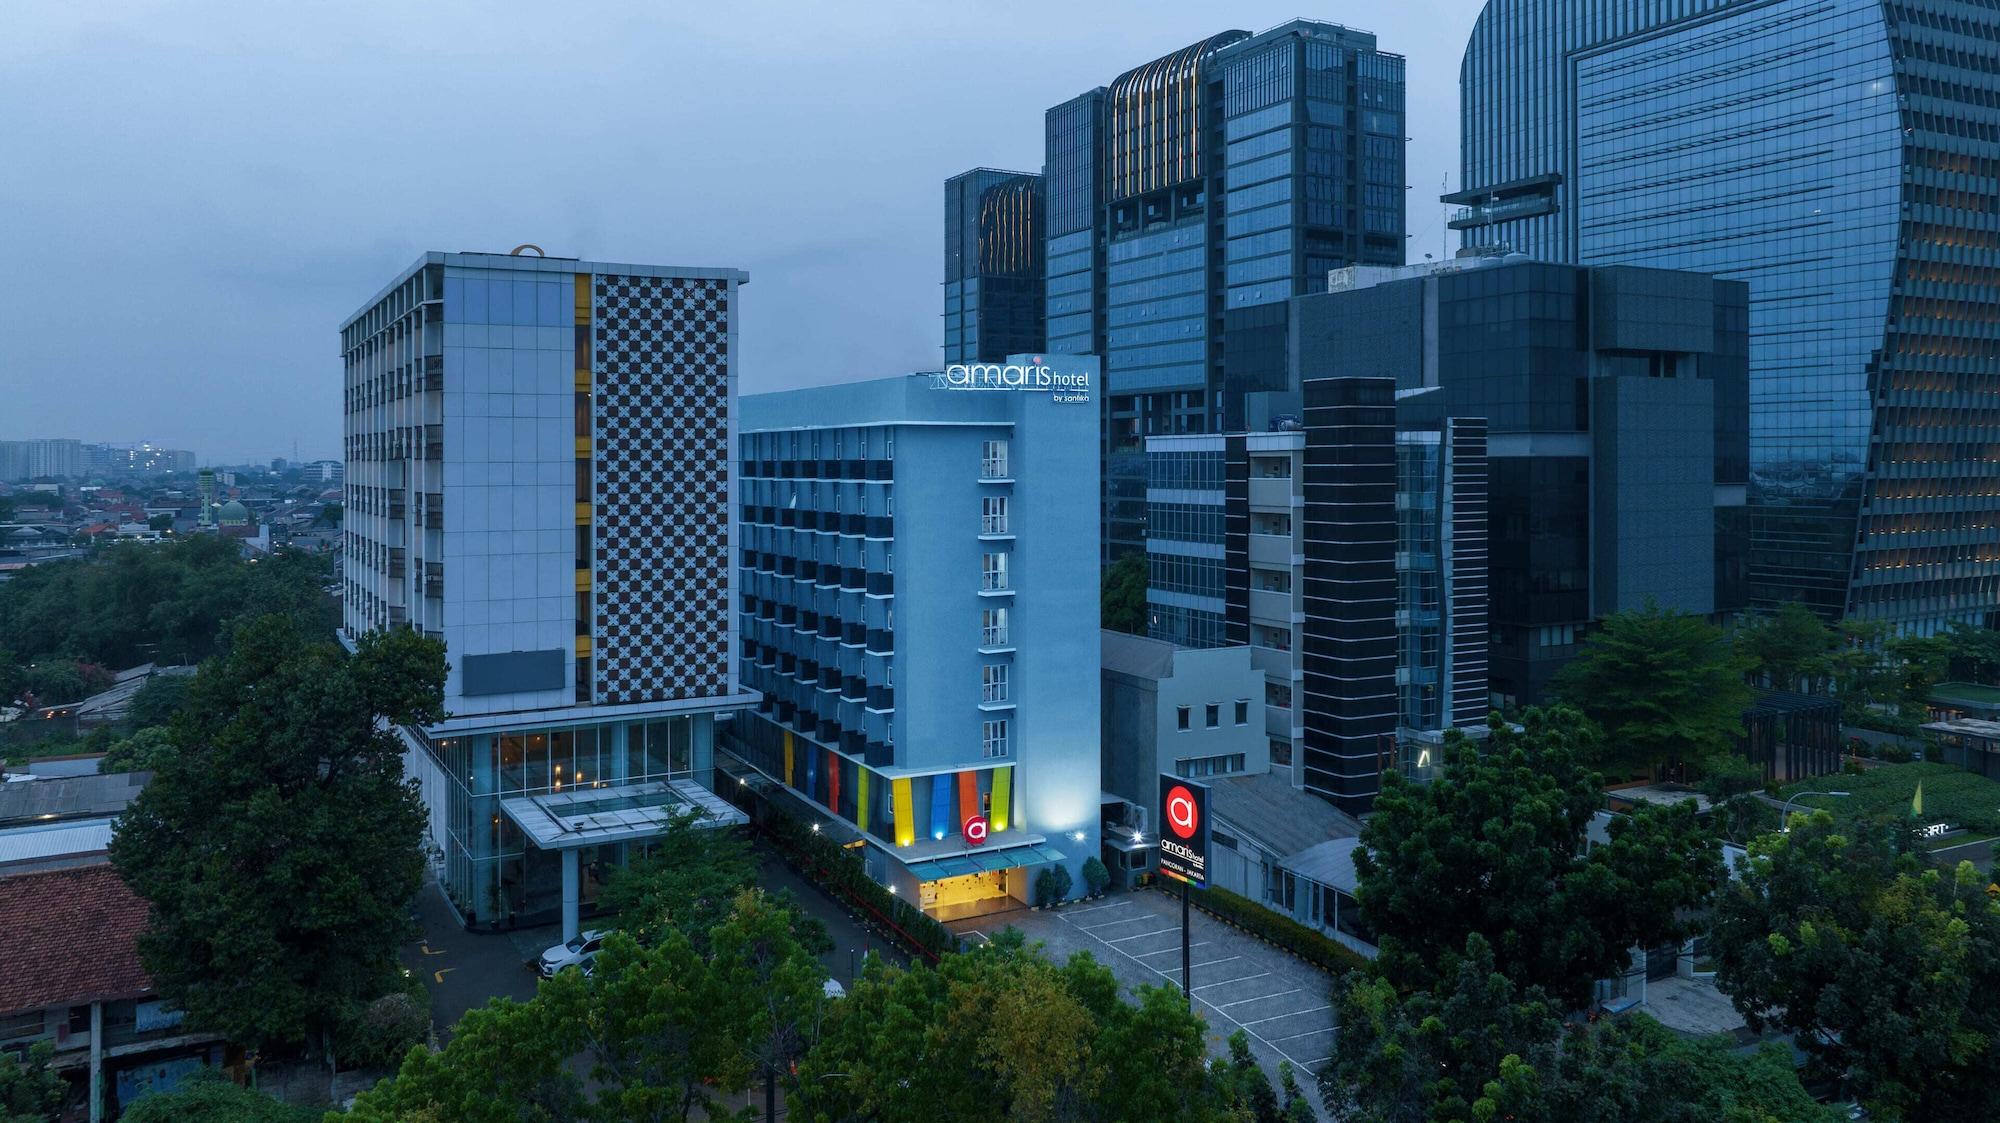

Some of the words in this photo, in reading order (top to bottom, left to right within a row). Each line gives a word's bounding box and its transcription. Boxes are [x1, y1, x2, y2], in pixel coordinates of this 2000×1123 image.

[947, 356, 1051, 385] amaris
[1053, 371, 1090, 386] hotel
[1053, 394, 1063, 403] by
[1170, 797, 1193, 829] a
[967, 821, 987, 839] a
[1161, 839, 1193, 859] amaris
[1161, 858, 1184, 872] PANCORAN
[1187, 869, 1204, 880] JAKARTA
